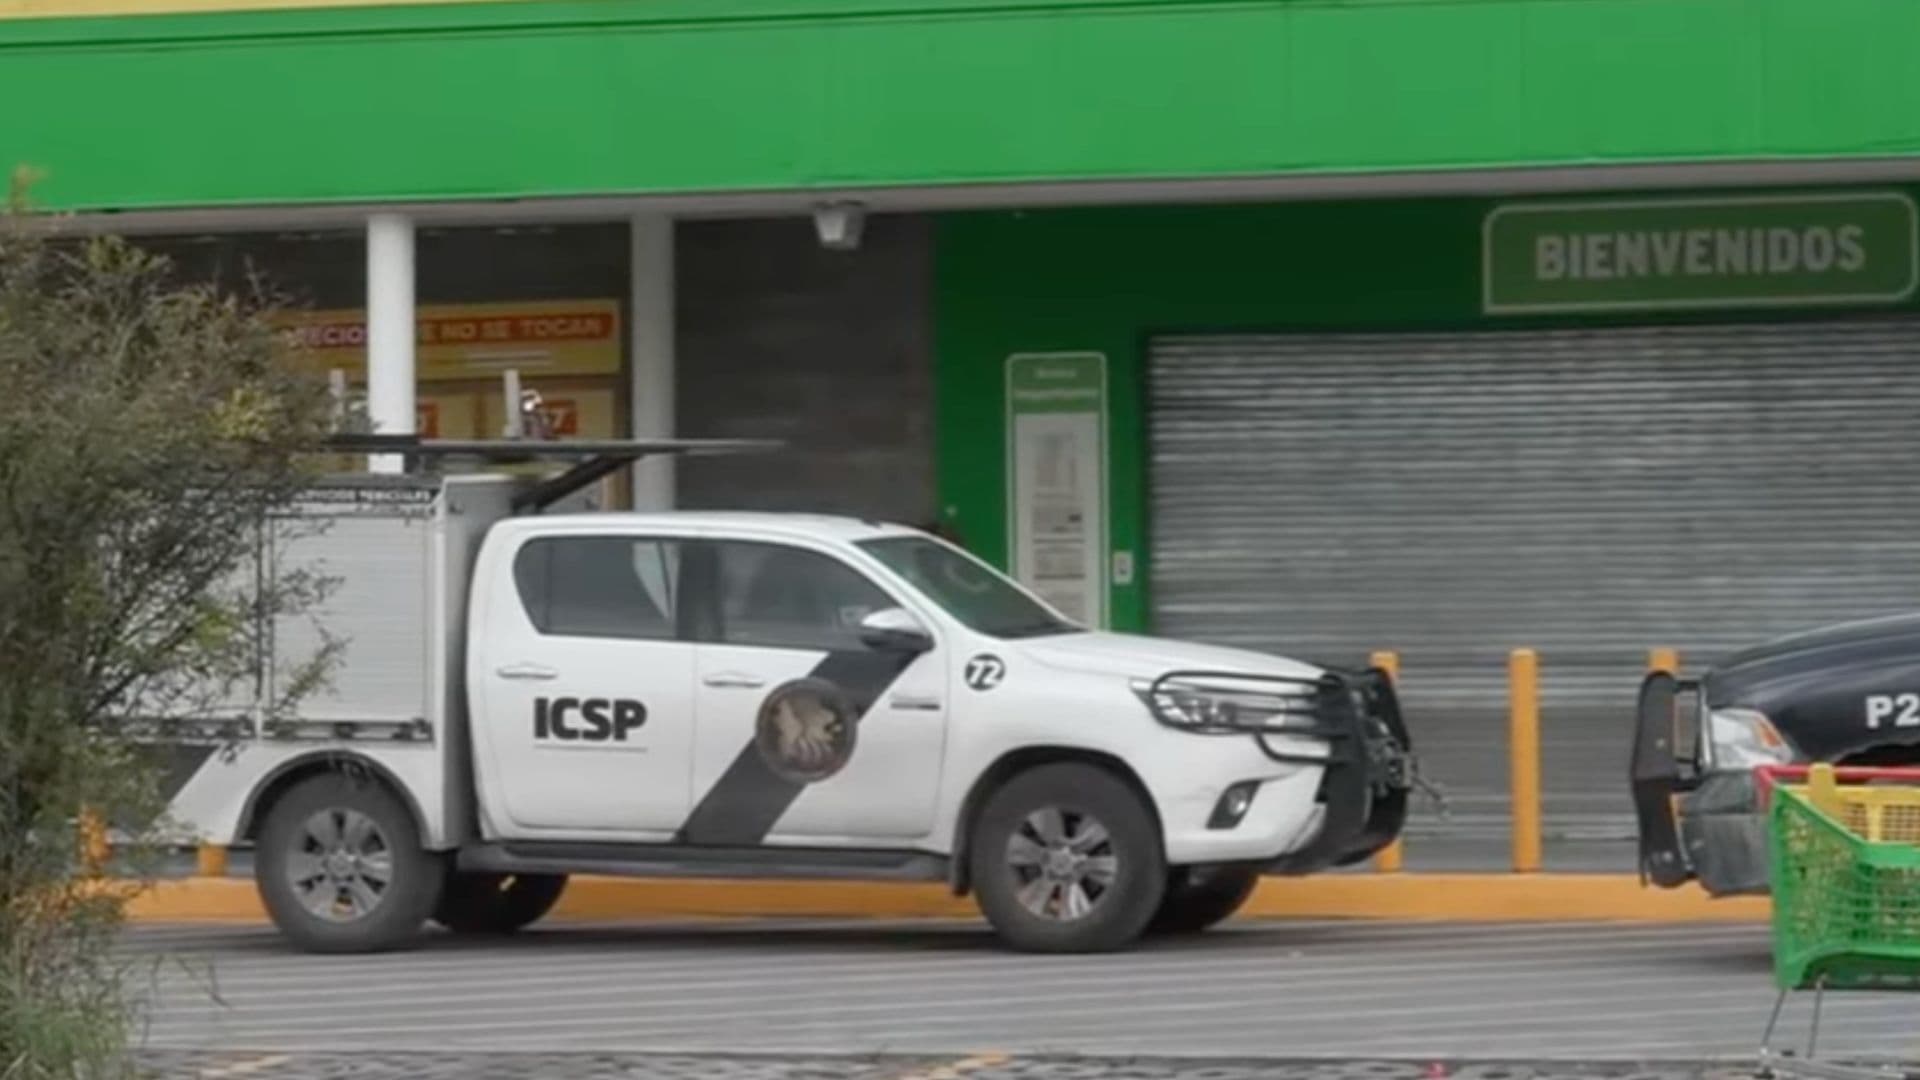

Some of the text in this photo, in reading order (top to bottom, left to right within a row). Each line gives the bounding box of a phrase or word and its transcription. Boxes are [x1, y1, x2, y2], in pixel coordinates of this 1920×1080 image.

[1535, 224, 1866, 281] BIENVENIDOS
[966, 659, 1002, 687] 72
[534, 696, 648, 742] ICSP
[1866, 693, 1920, 729] P2
